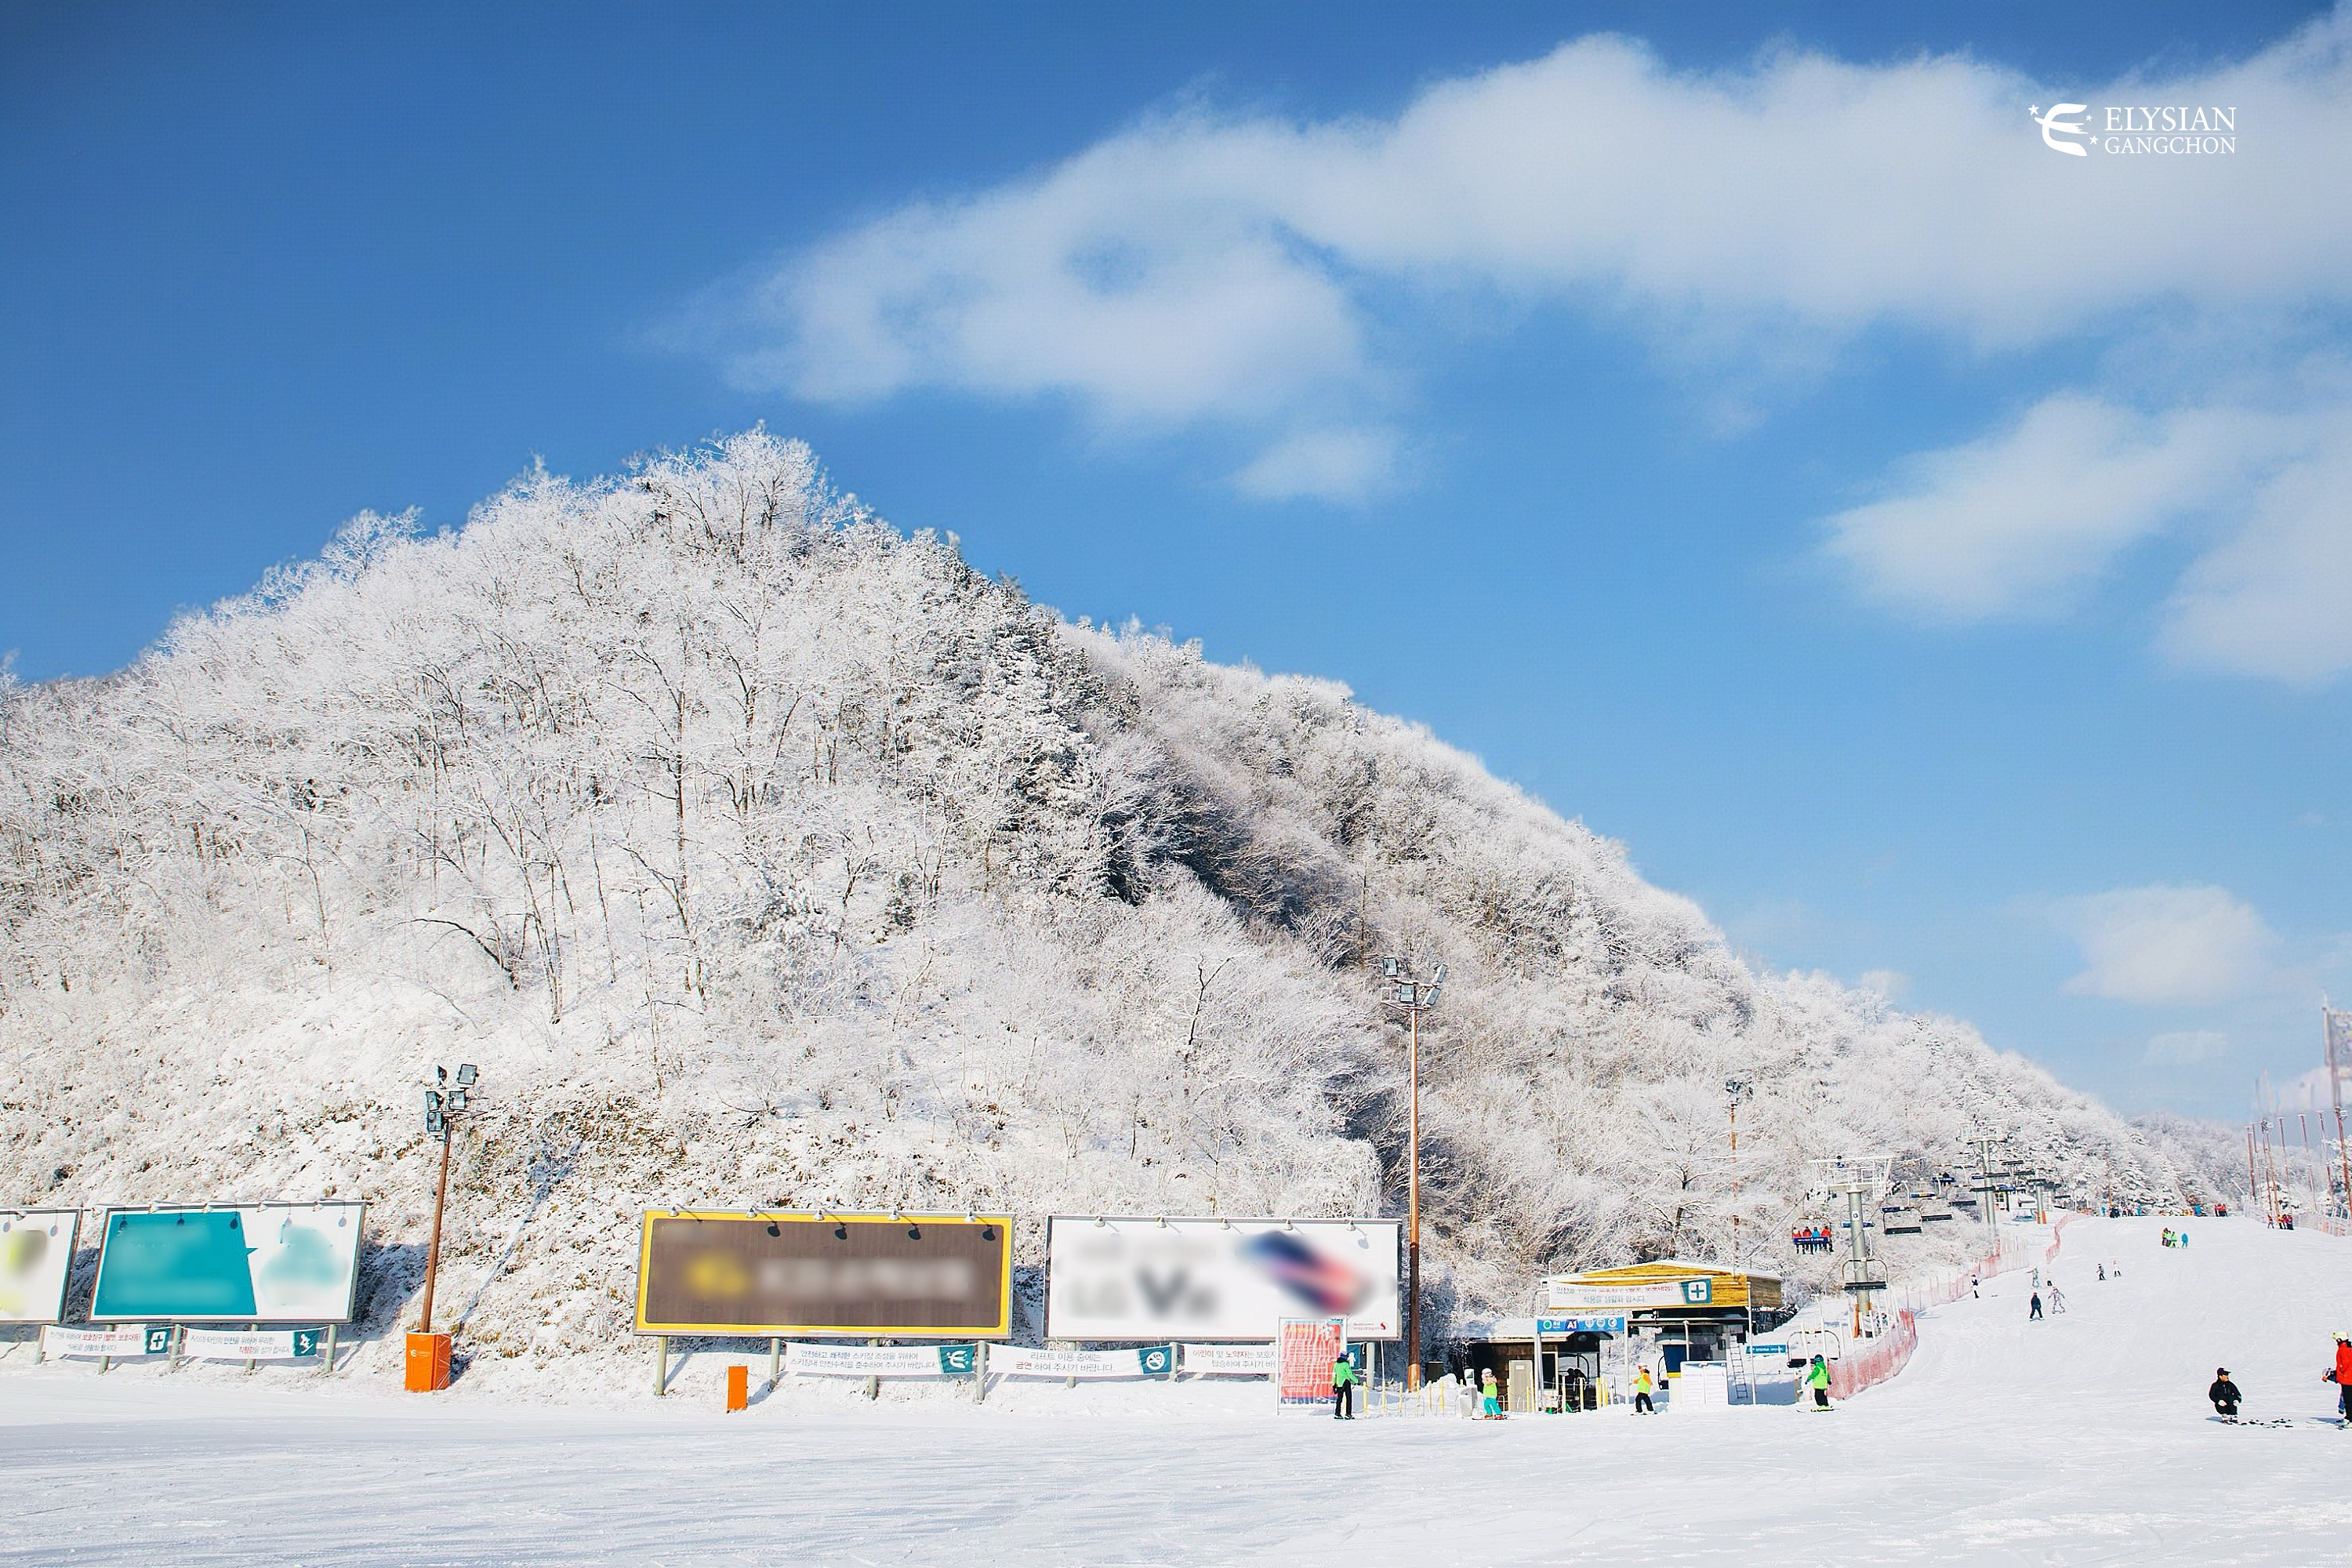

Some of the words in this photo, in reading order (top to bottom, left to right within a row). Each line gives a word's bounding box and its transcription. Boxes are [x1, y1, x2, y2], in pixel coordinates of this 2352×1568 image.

[1566, 1320, 1577, 1330] A1
[1030, 1352, 1056, 1361] 리프트
[1058, 1352, 1074, 1362] 이용
[1076, 1352, 1102, 1363] 중에는
[1192, 1349, 1214, 1358] 어린이
[1225, 1350, 1254, 1359] 노약자는
[1015, 1361, 1033, 1370] 금연
[1034, 1363, 1051, 1371] 하여
[1054, 1363, 1079, 1371] 주시기
